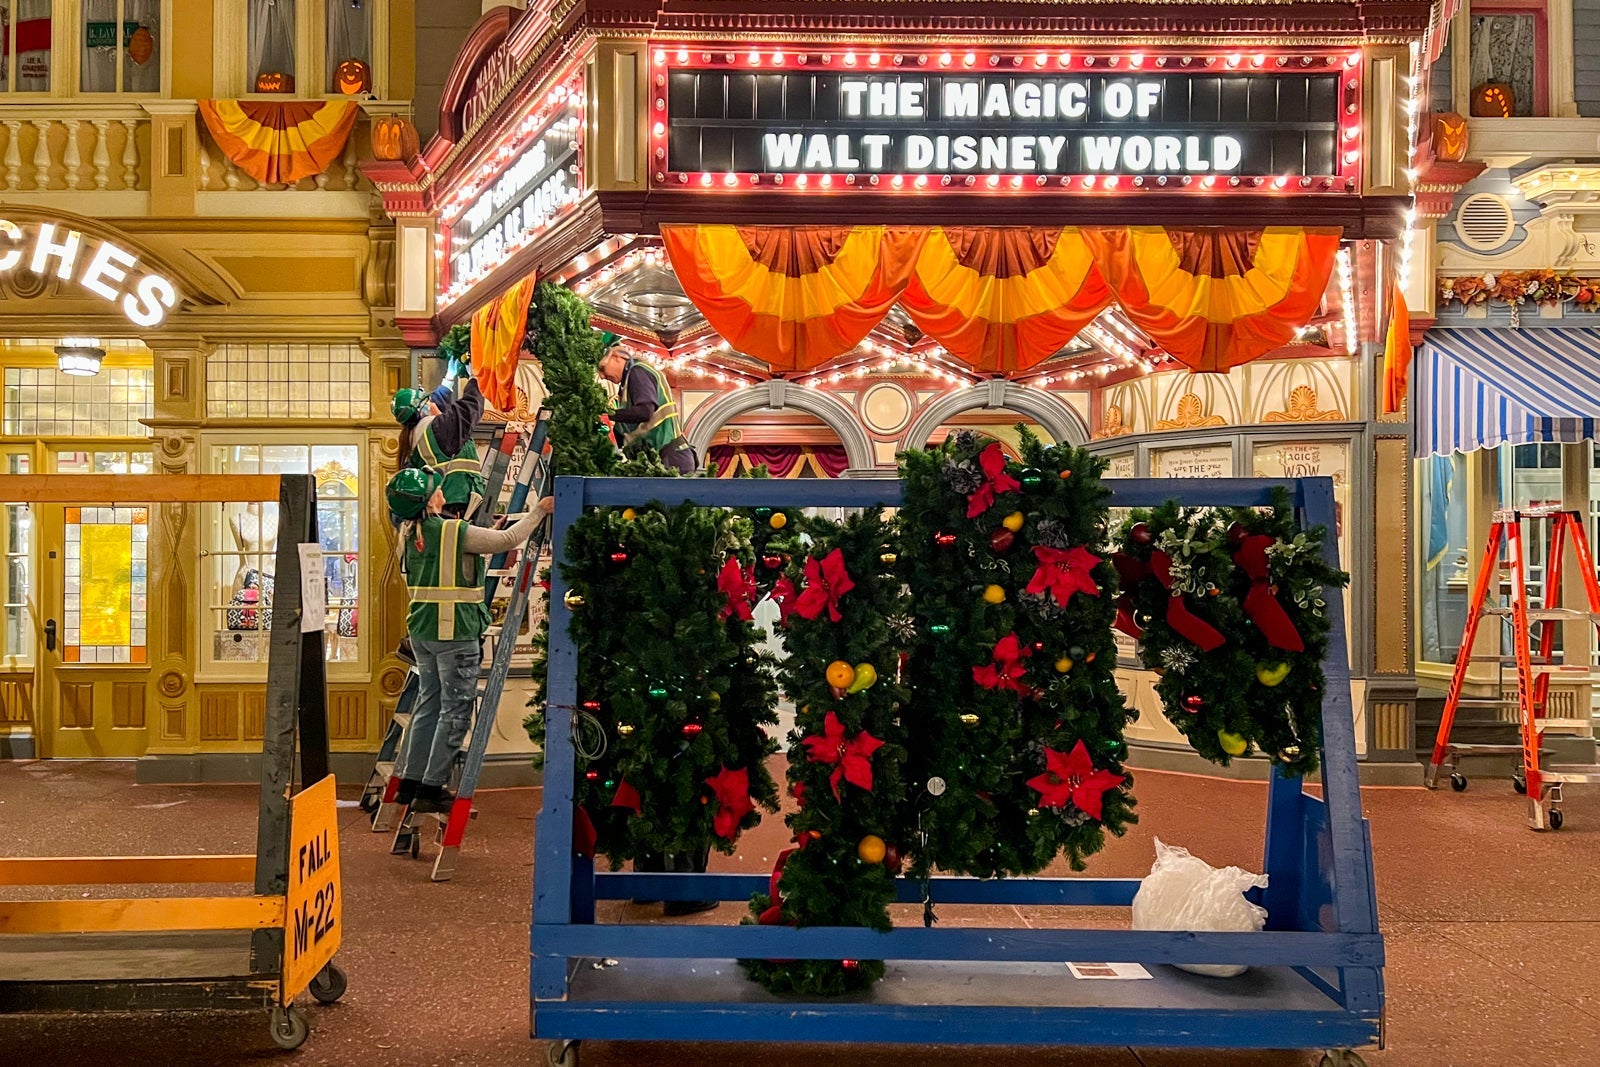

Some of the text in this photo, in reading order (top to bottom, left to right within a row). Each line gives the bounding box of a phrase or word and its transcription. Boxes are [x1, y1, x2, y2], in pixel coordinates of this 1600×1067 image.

[99, 28, 132, 38] LAVL
[475, 51, 497, 92] MAIN
[462, 53, 511, 134] CINEM
[841, 81, 1162, 118] THE MAGIC OF
[763, 133, 1243, 171] WALT DISNEY WORLD
[1188, 464, 1206, 473] THE
[299, 828, 331, 885] FALL
[293, 881, 335, 961] M-22
